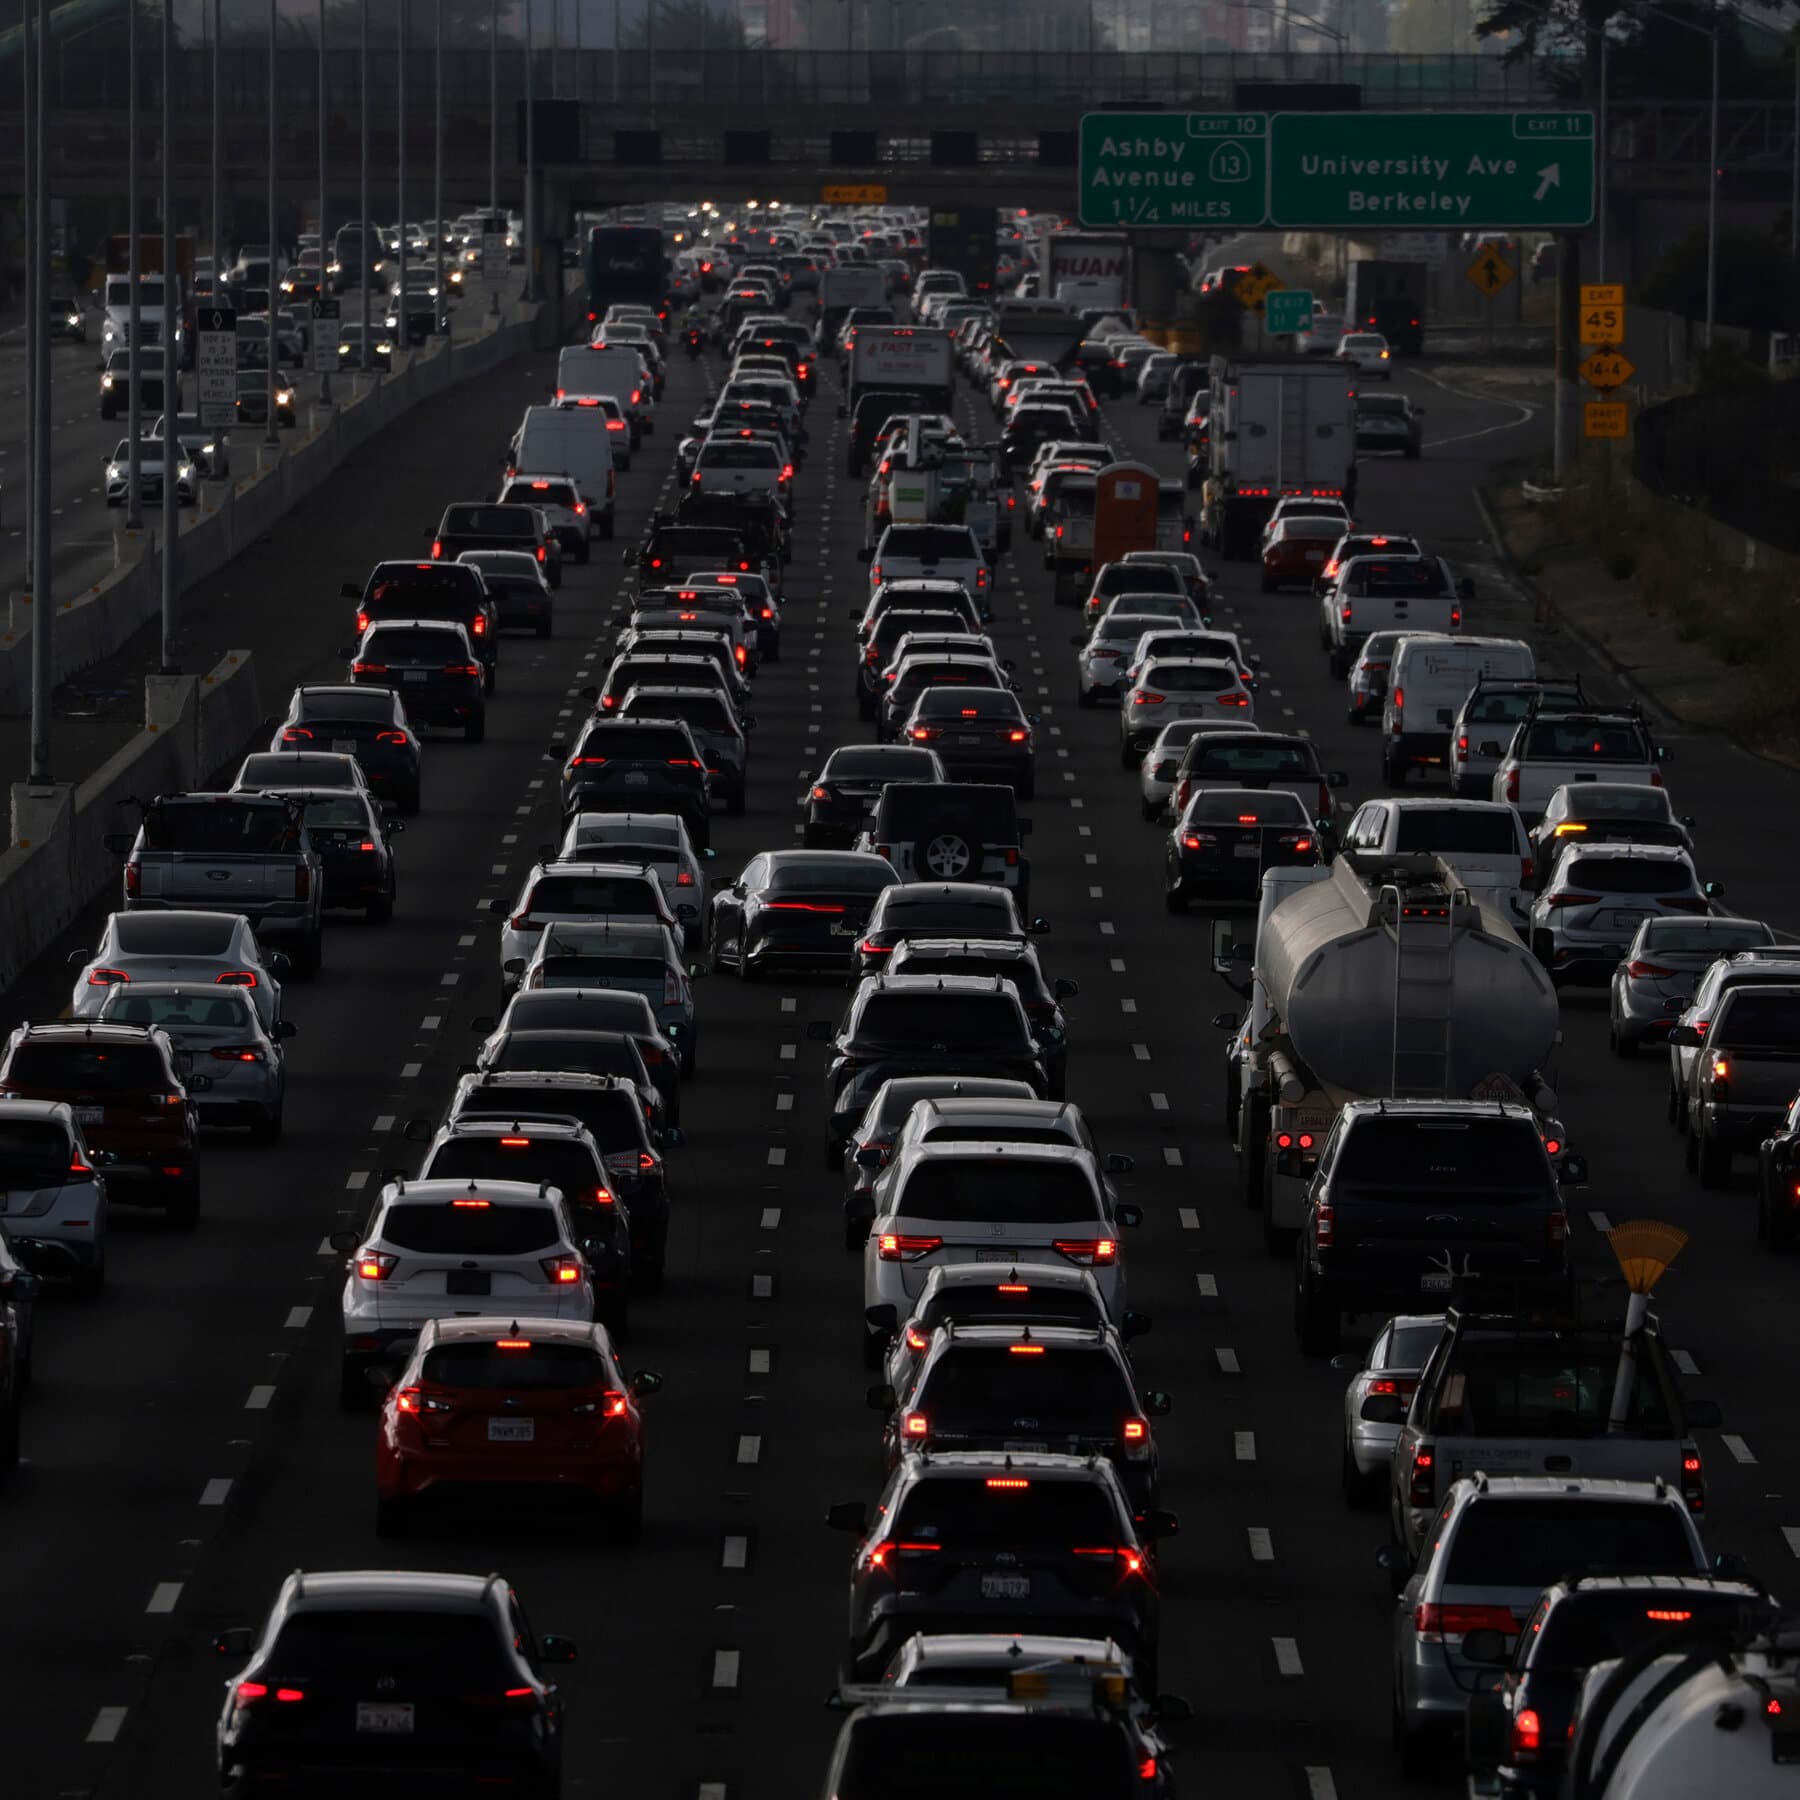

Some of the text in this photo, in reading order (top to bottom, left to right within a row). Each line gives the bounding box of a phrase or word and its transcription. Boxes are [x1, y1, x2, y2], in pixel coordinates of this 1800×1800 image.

[1199, 117, 1257, 134] EXIT 10
[1527, 117, 1581, 133] EXIT 11
[1098, 136, 1187, 163] Ashby
[1219, 155, 1241, 176] 13
[1301, 154, 1518, 180] University Ave
[1091, 165, 1196, 187] Avenue
[1169, 200, 1233, 218] MILES
[1347, 190, 1472, 216] Berkeley
[1055, 257, 1122, 276] RUAN
[1272, 296, 1304, 310] EXIT
[1590, 289, 1614, 300] EXIT
[1586, 310, 1617, 328] 45
[881, 342, 913, 352] FAST
